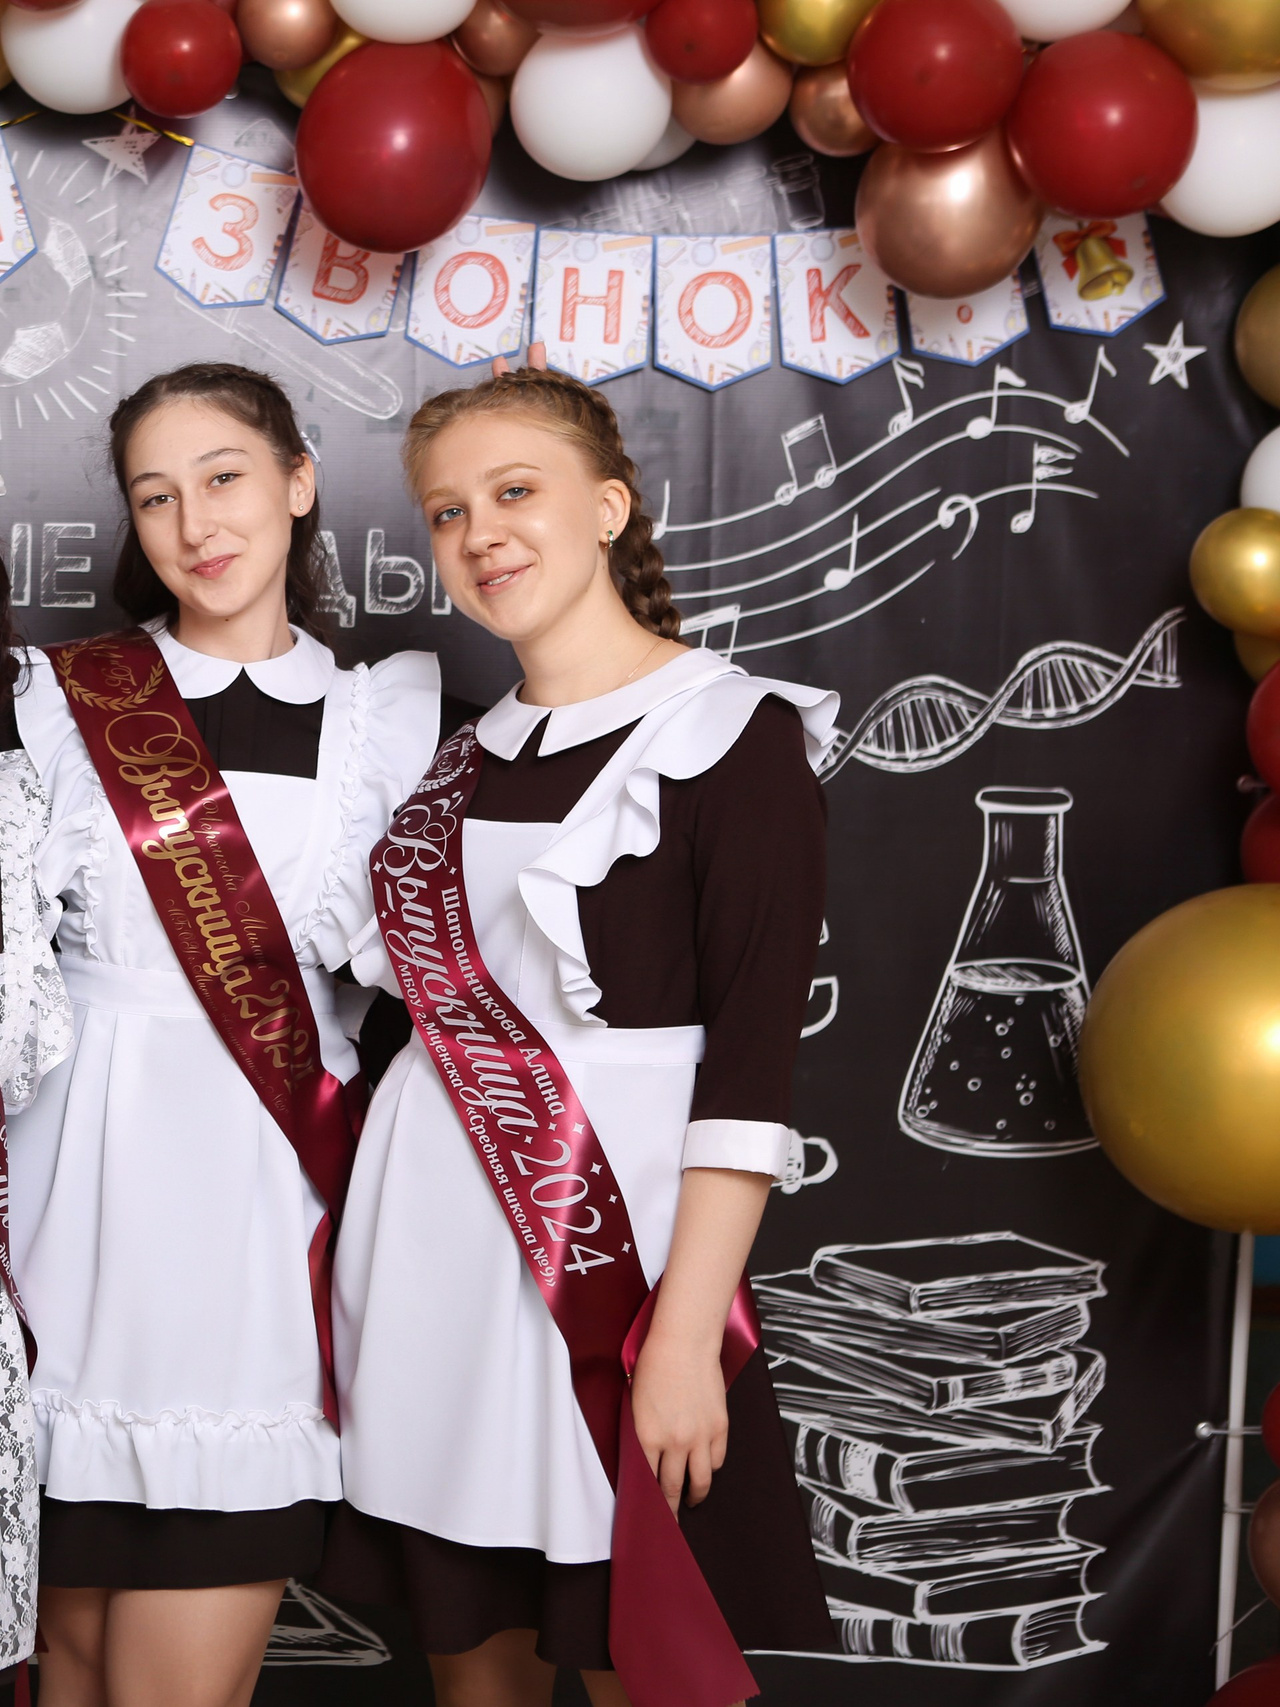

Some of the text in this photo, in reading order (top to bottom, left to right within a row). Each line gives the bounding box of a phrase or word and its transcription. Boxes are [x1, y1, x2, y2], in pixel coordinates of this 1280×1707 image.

[192, 192, 973, 349] ЗВОНОК
[105, 711, 252, 997] Выпускница
[382, 798, 616, 1276] Выпускница 2024
[398, 963, 424, 1008] МБОУ
[465, 1106, 509, 1186] «Средняя
[502, 1186, 538, 1246] школа
[441, 885, 567, 1117] Шапошникова Алина
